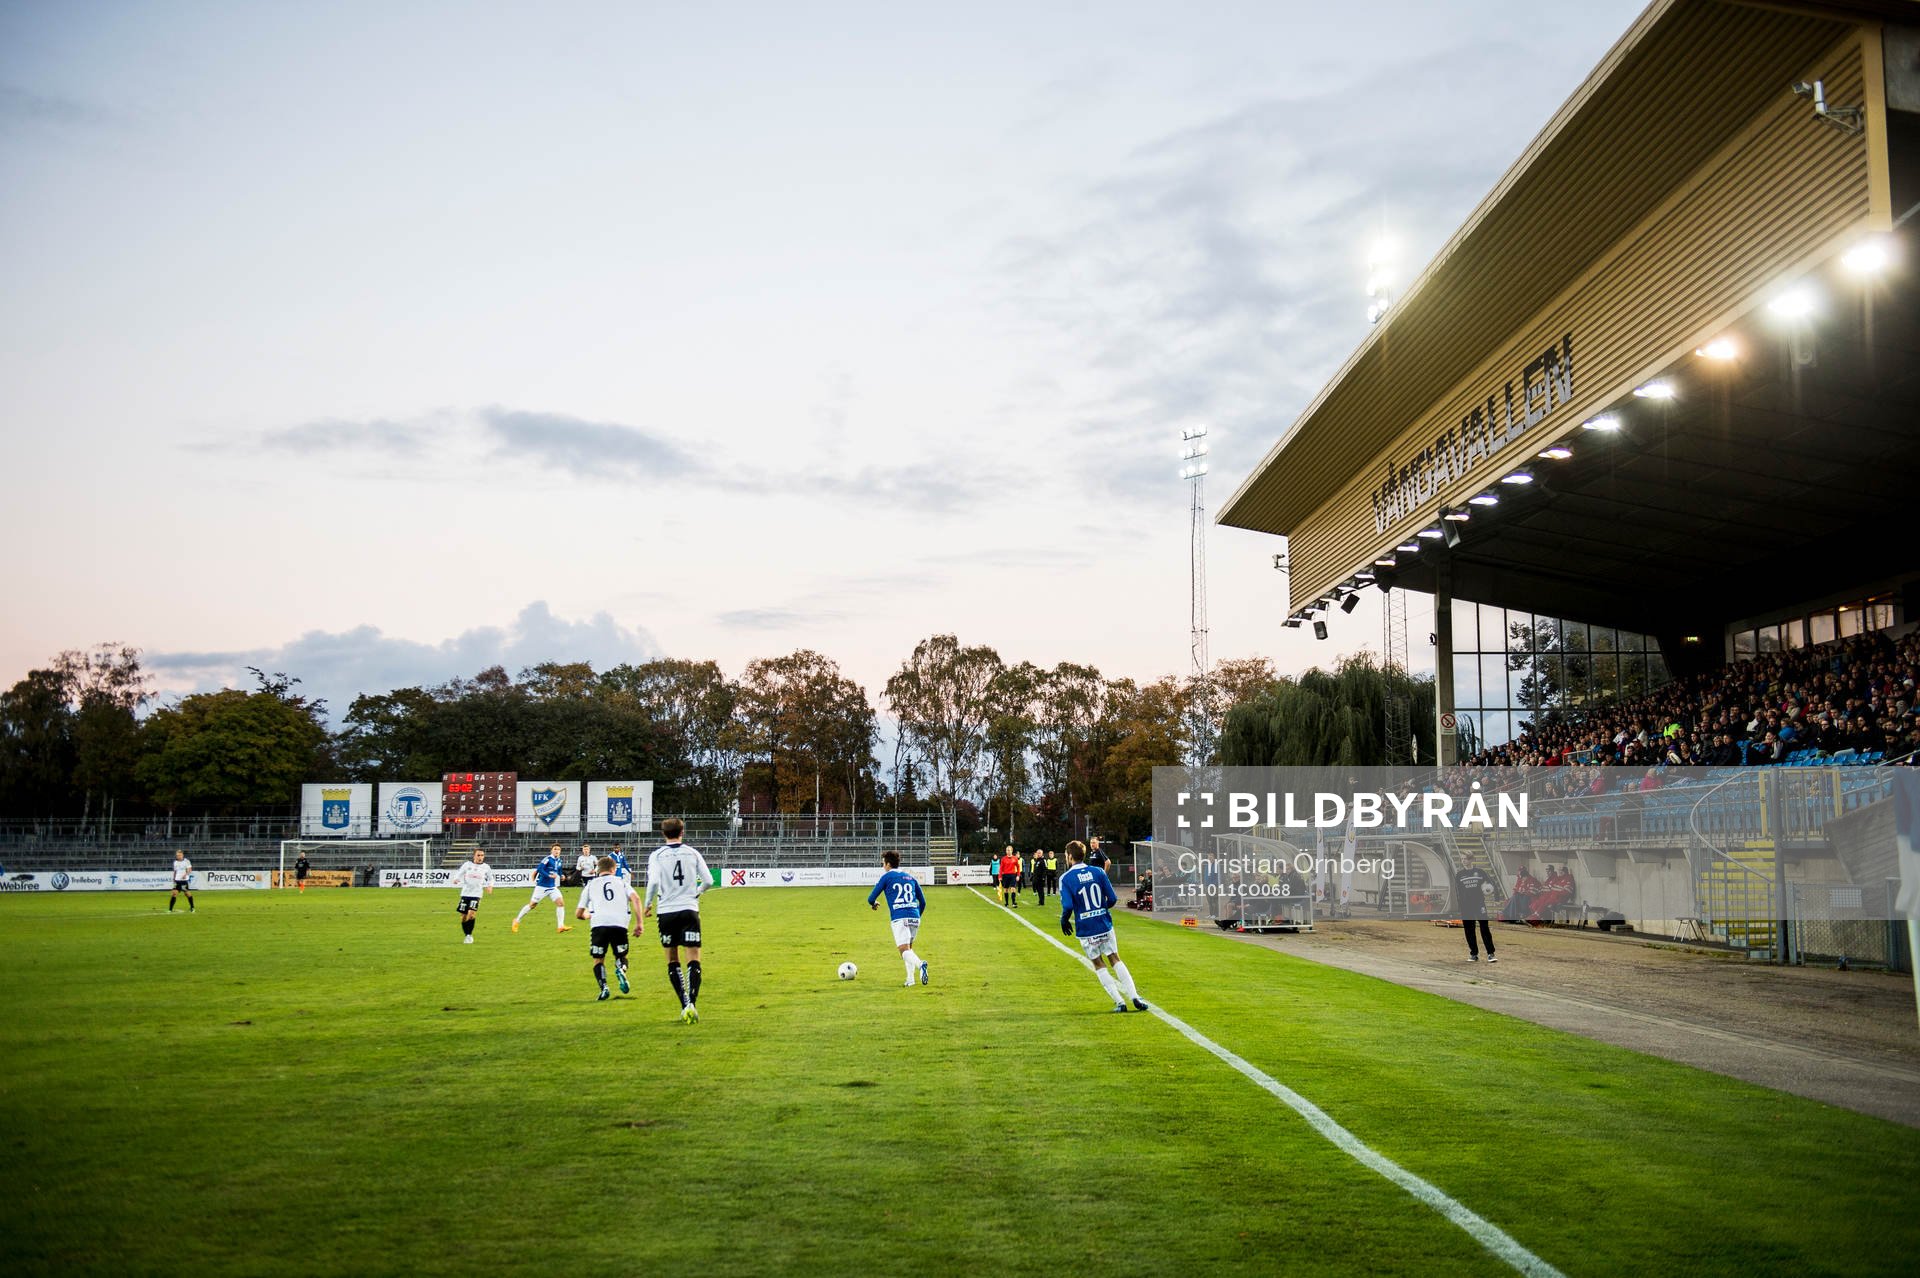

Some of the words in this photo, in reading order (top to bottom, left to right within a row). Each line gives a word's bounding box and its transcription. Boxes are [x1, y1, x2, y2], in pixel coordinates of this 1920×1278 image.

[1372, 332, 1572, 536] VÅNGAVALLEN
[534, 793, 550, 801] IFK
[207, 871, 256, 882] PREVENTIQ
[385, 872, 401, 880] BIL
[403, 872, 451, 880] LARSSON
[492, 873, 530, 882] ERSSON
[672, 860, 685, 886] 4
[749, 871, 766, 879] KFX
[0, 881, 40, 890] WebTree
[603, 881, 615, 901] 6
[892, 883, 914, 903] 28
[1078, 882, 1102, 911] 10
